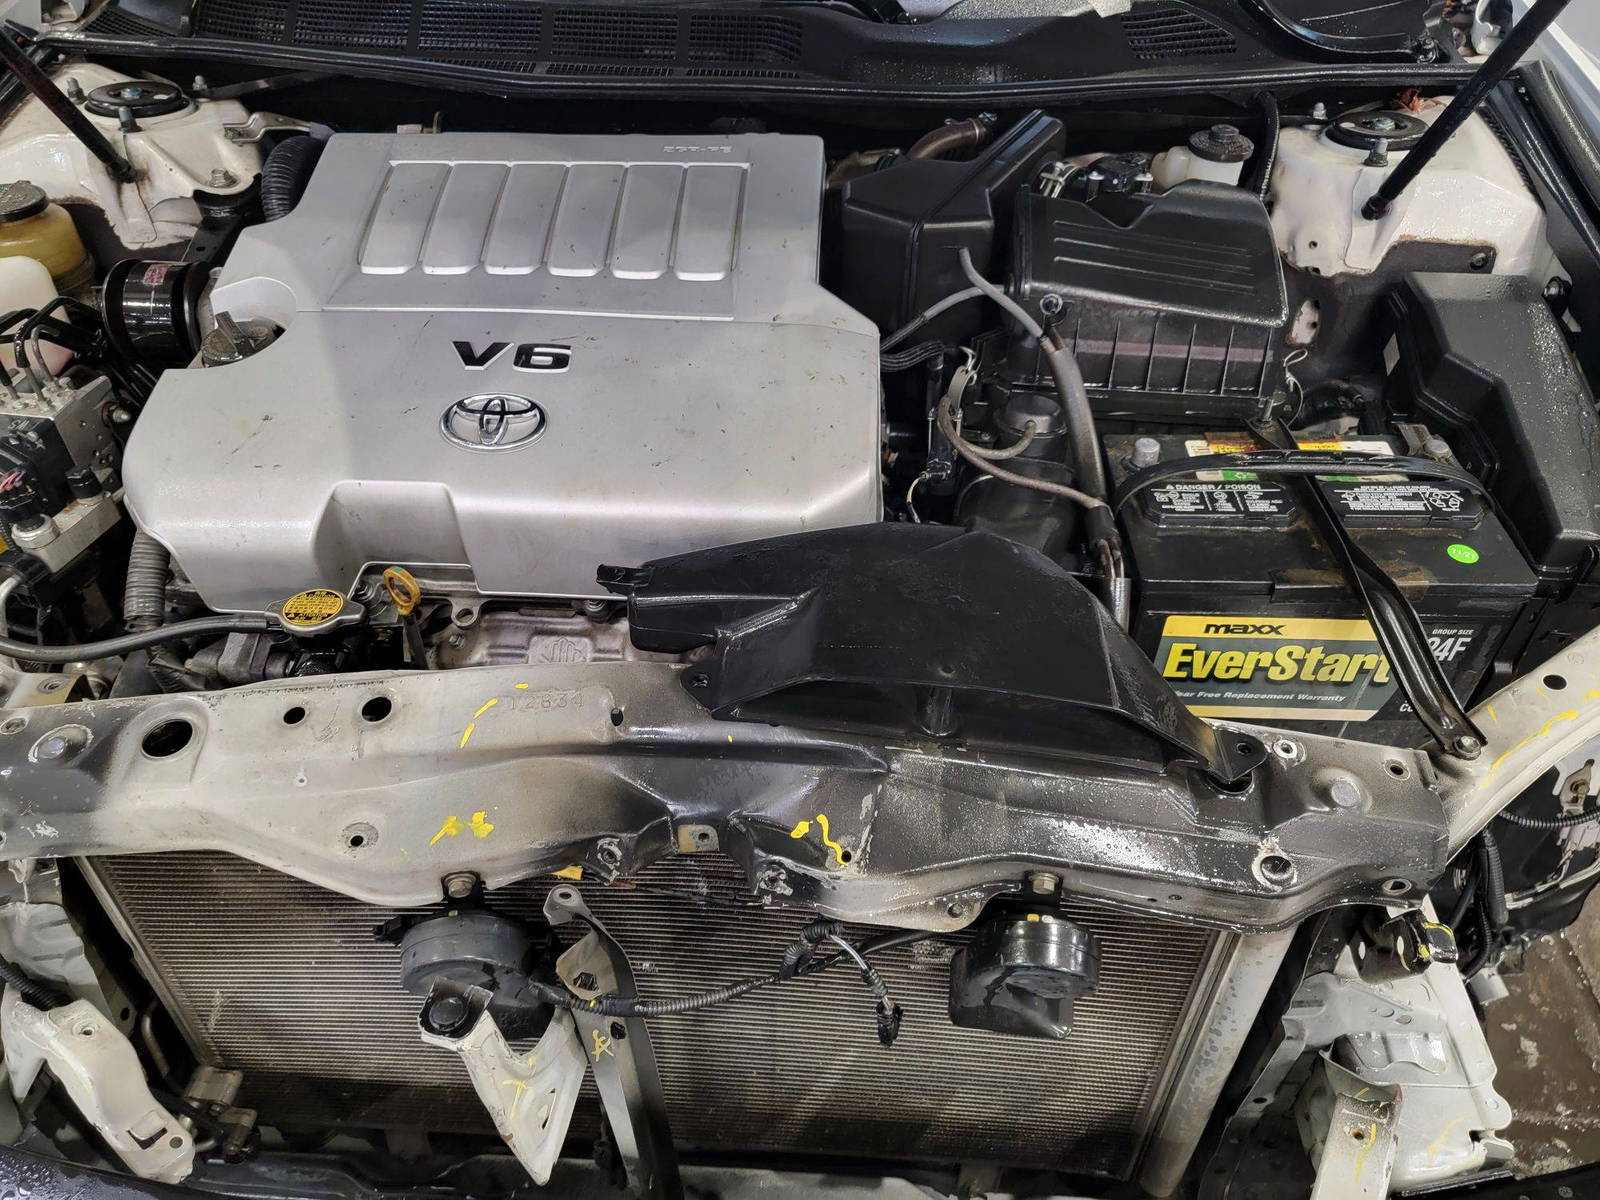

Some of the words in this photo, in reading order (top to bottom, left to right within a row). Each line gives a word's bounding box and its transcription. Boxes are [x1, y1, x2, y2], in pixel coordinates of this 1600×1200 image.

[451, 341, 573, 374] V6
[1203, 624, 1286, 636] maxx
[1162, 642, 1391, 683] EverStart
[1223, 691, 1295, 700] Replacement
[1297, 693, 1346, 703] Warranty
